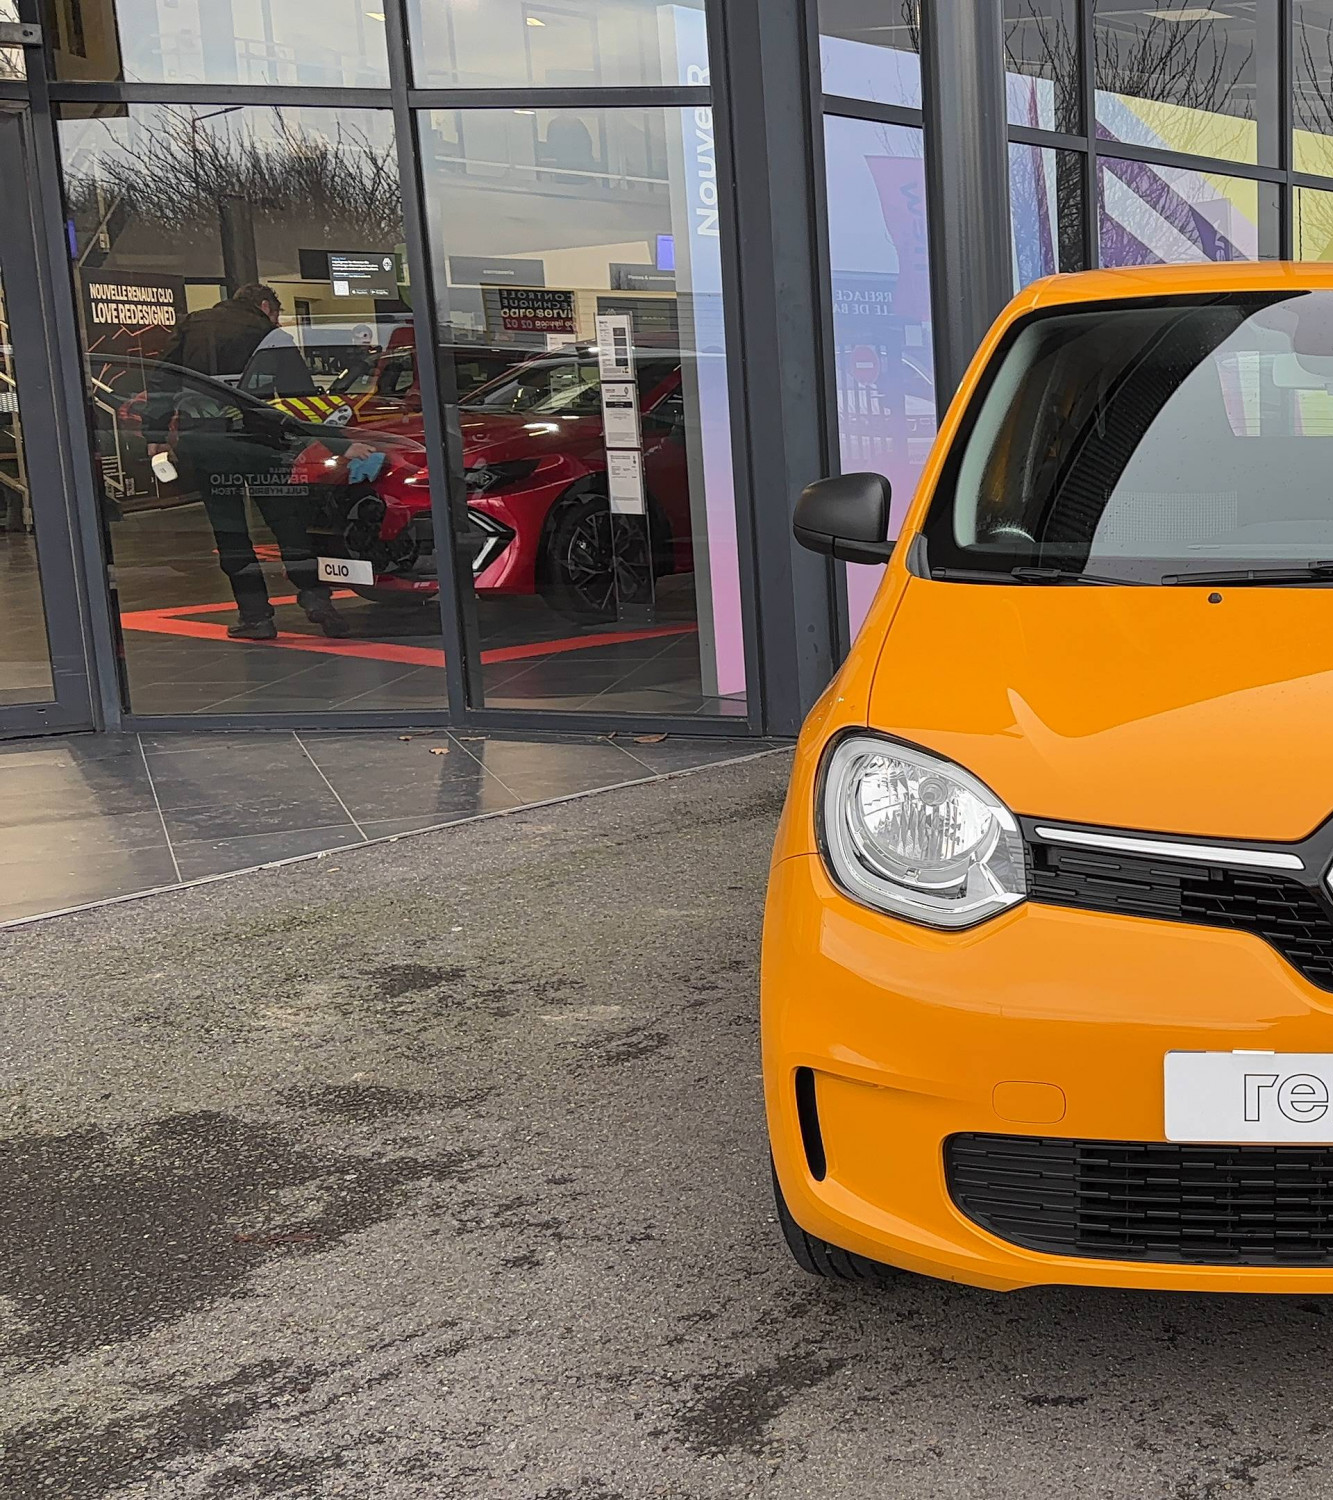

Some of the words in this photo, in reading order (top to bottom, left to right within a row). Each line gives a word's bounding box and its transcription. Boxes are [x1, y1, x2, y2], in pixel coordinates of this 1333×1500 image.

[89, 283, 127, 300] NOUVELLE
[127, 286, 158, 302] RENAULT
[158, 288, 174, 303] CLIO
[92, 302, 118, 323] LOVE
[118, 303, 176, 325] REDESIGNED
[324, 563, 349, 577] CLIO
